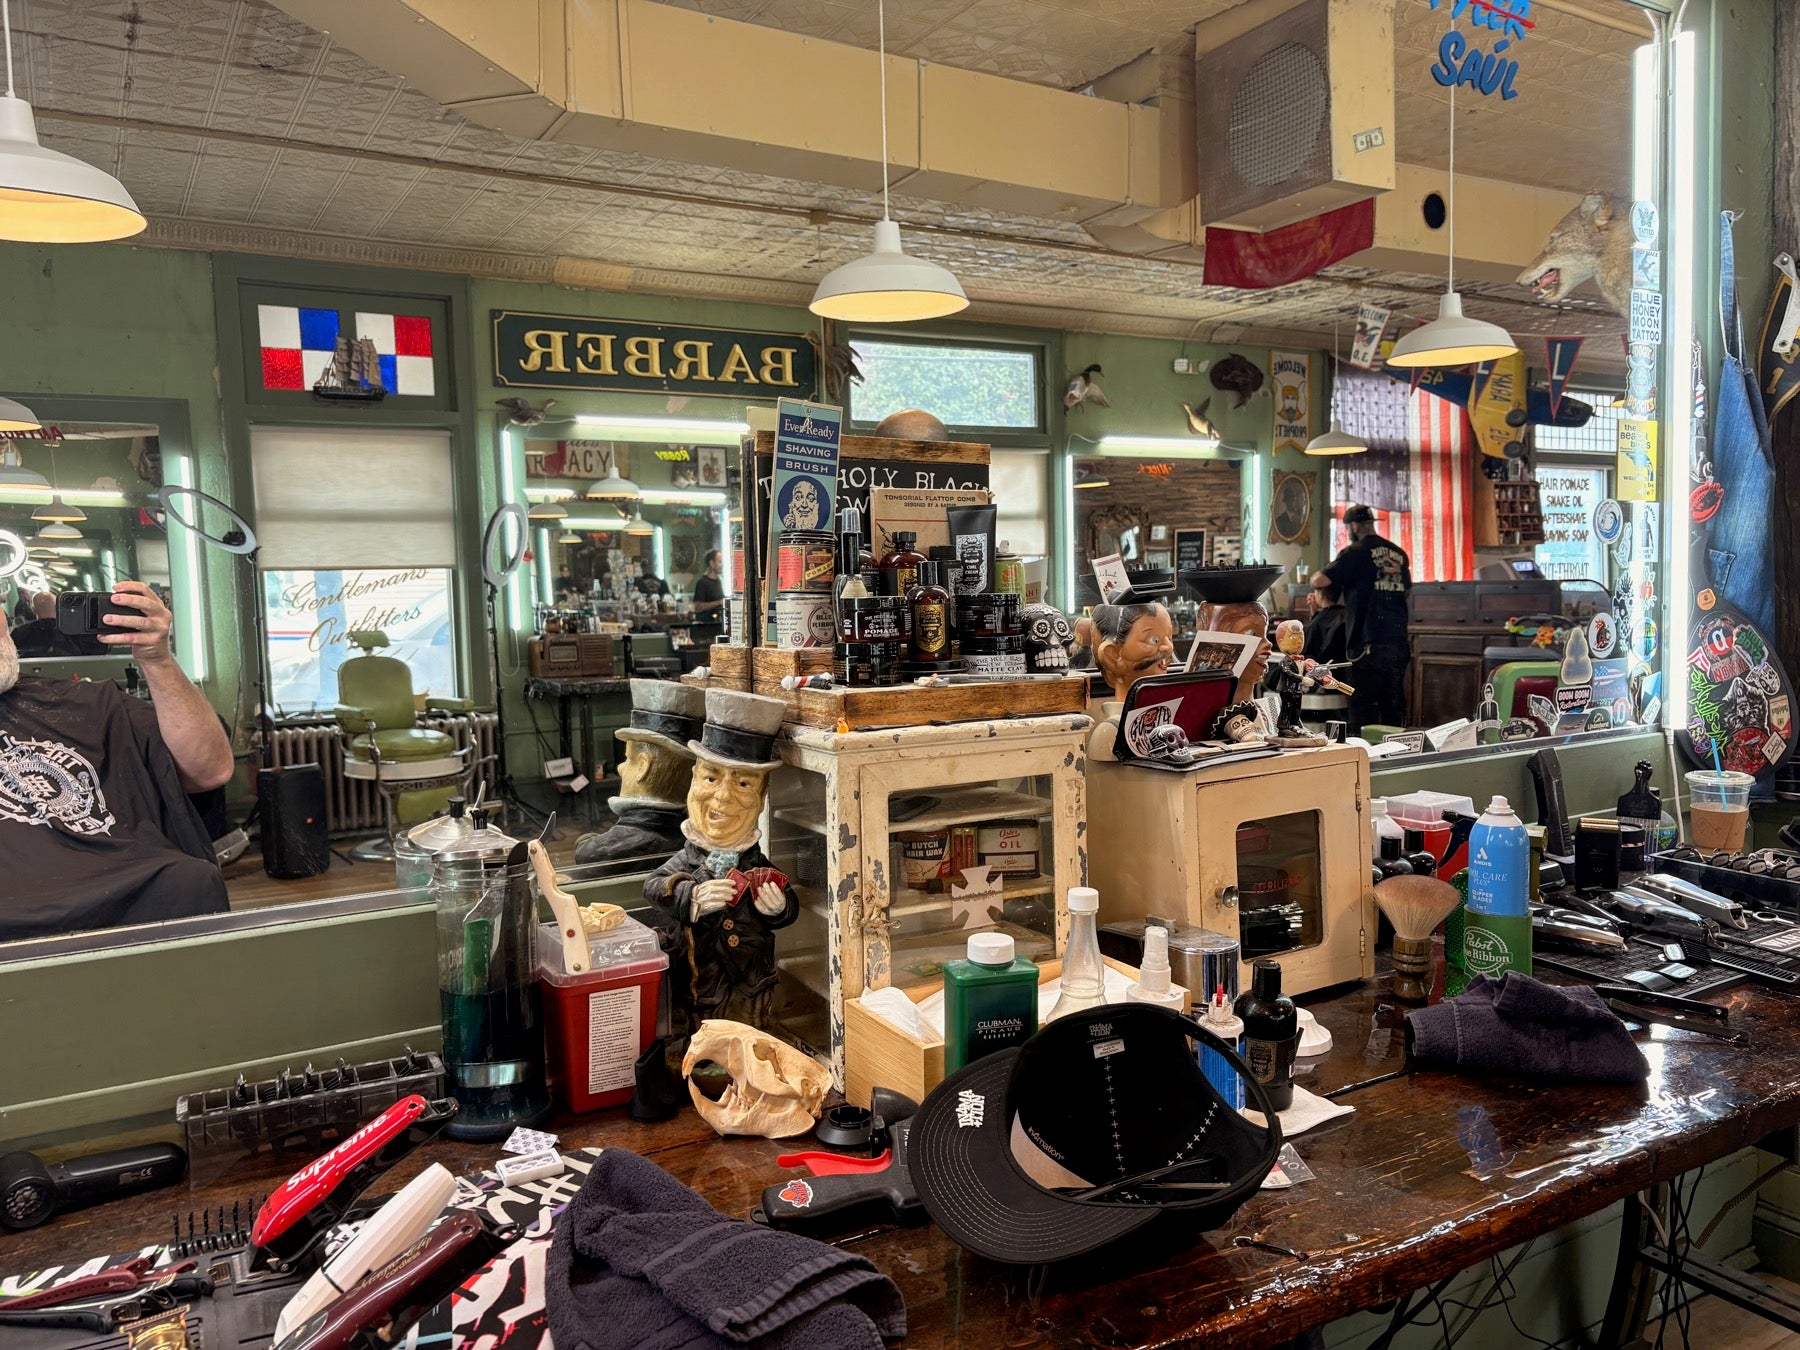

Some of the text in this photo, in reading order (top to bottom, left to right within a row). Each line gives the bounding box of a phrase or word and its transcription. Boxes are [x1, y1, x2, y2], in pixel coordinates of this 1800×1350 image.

[1632, 292, 1660, 304] BLUE
[1360, 308, 1388, 322] WELCOME
[1632, 304, 1660, 317] HONEY
[1632, 316, 1659, 328] MOON
[1632, 328, 1660, 341] TATTOO
[785, 444, 831, 458] SHAVING
[785, 460, 829, 474] BRUSH
[1540, 479, 1590, 491] HAIR POMADE
[884, 494, 922, 502] TONSORIAL
[1546, 496, 1582, 507] SNAKE OIL
[1544, 513, 1587, 524] AFTERSHAVE
[1572, 530, 1588, 542] SOAP
[1558, 692, 1574, 700] BOOM
[1574, 690, 1590, 698] BOOM
[912, 841, 938, 849] BUTCH
[926, 848, 942, 856] WAX
[1483, 872, 1508, 881] CARE
[1472, 896, 1492, 904] BLADES
[1466, 933, 1493, 950] Pabst
[1472, 950, 1510, 964] Ribbon
[978, 1018, 1021, 1028] CLUBMAN
[286, 1113, 391, 1192] Supreme
[385, 1251, 422, 1279] cordless
